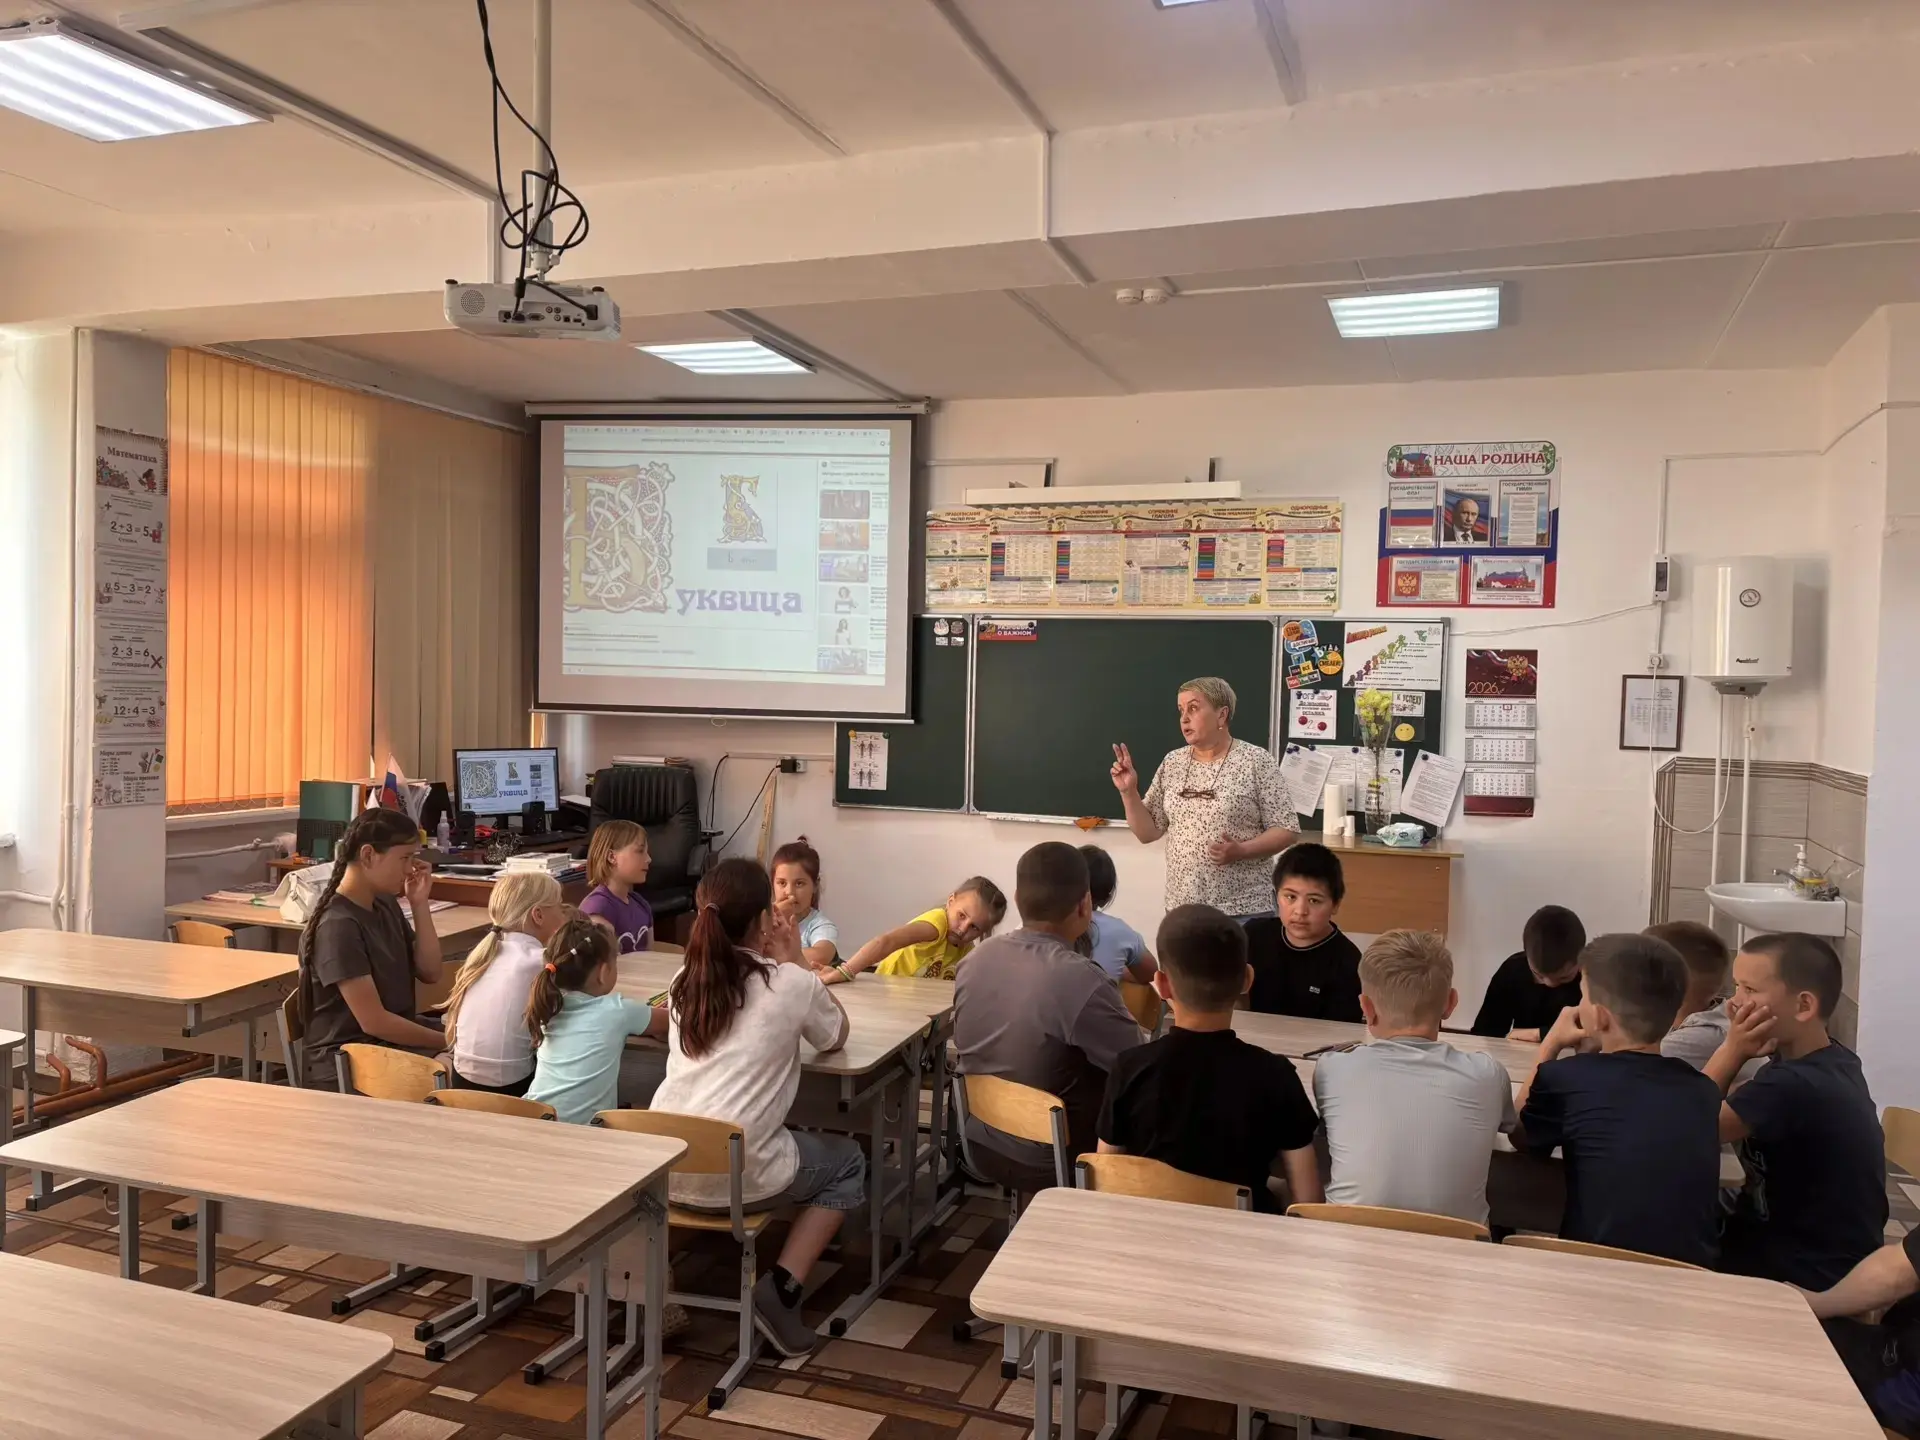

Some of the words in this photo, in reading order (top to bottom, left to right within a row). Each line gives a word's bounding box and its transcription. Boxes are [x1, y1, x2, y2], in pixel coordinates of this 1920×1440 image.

[107, 446, 158, 464] Математика
[1434, 454, 1478, 466] НАША
[1482, 452, 1546, 465] РОДИНА
[1468, 682, 1498, 694] 2026
[1402, 694, 1422, 705] УСПЕХУ
